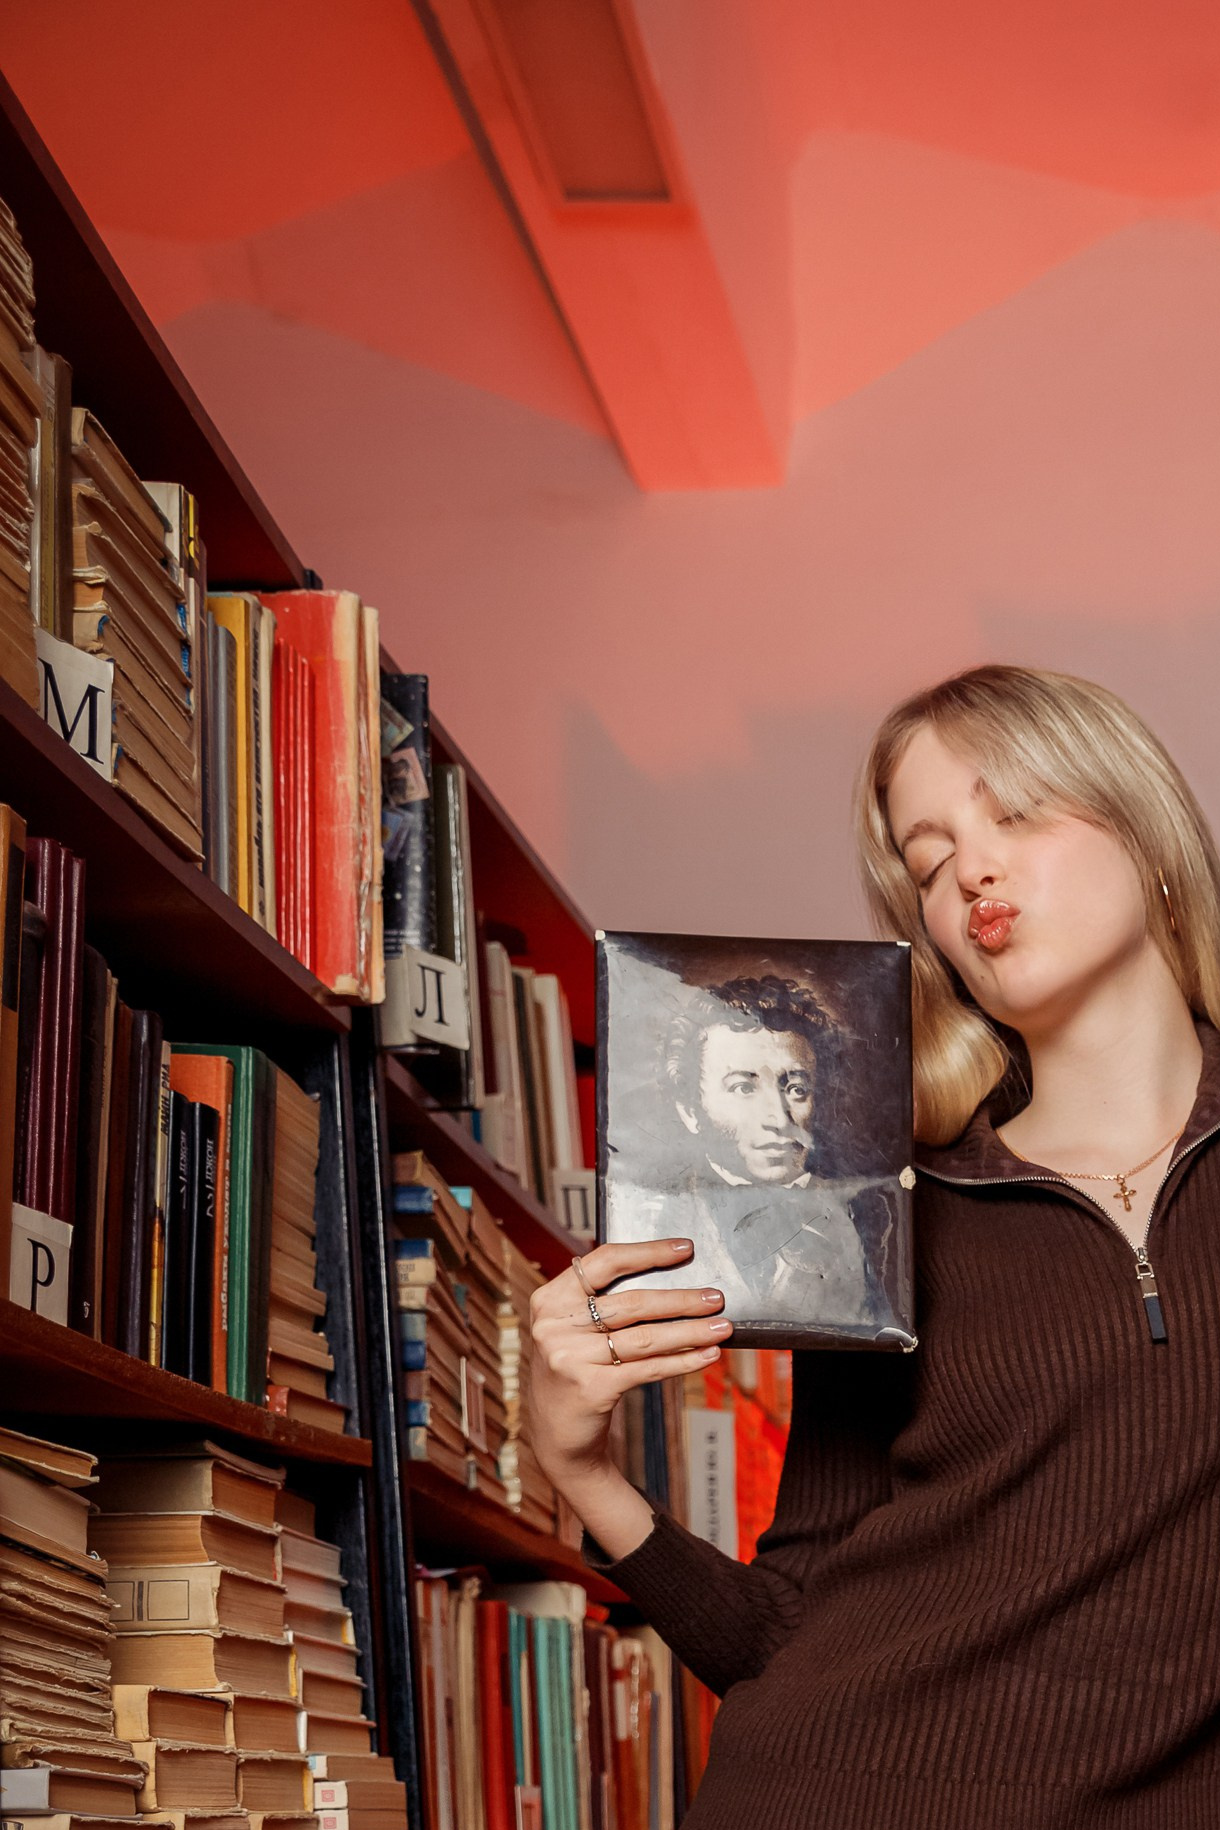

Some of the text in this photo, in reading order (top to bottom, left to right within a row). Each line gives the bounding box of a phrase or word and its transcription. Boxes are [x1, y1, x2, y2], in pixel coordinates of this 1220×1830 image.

[38, 658, 105, 765] М
[415, 965, 451, 1027] Л
[27, 1238, 56, 1311] Р
